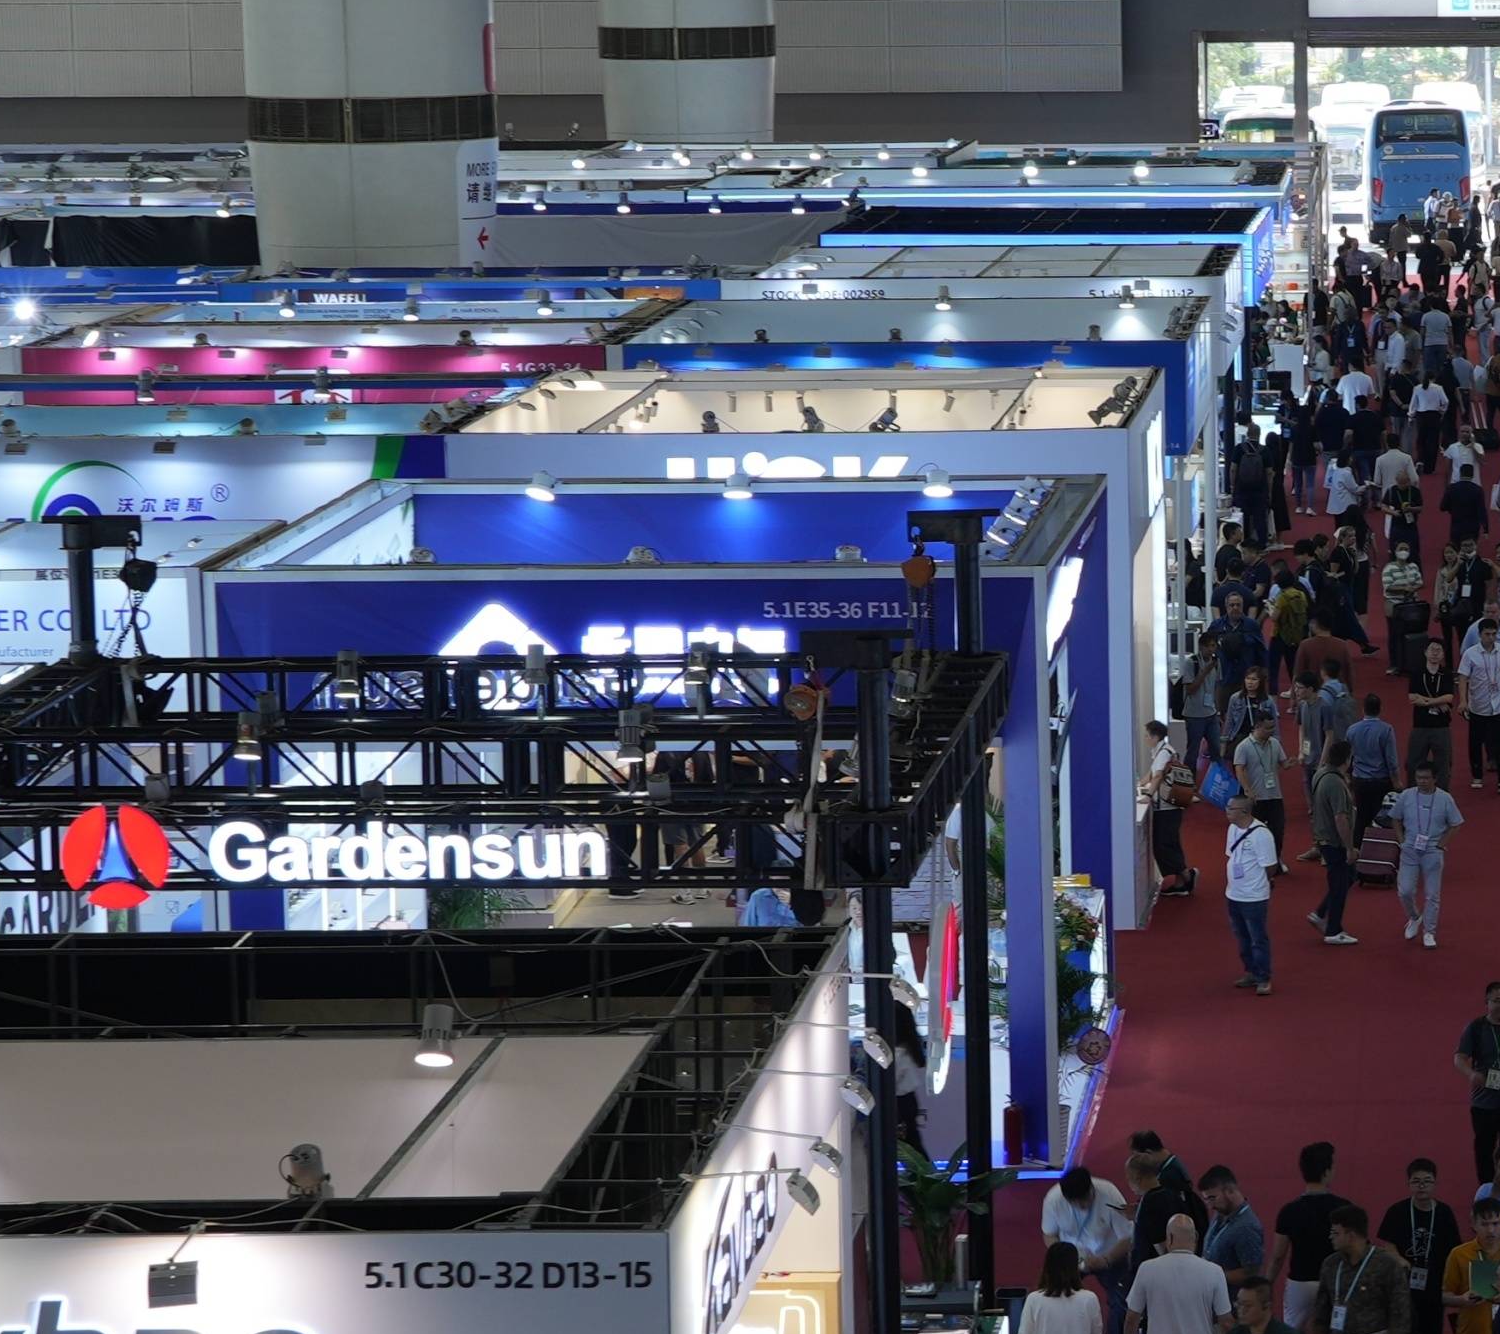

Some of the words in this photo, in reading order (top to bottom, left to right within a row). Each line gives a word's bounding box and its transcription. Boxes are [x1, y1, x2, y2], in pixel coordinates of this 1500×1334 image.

[116, 496, 205, 514] 沃尔姆斯
[763, 601, 863, 620] 5.1E35-36
[207, 820, 608, 883] Gardensun
[364, 1261, 533, 1290] 5.1C30-32
[541, 1260, 653, 1289] D13-15
